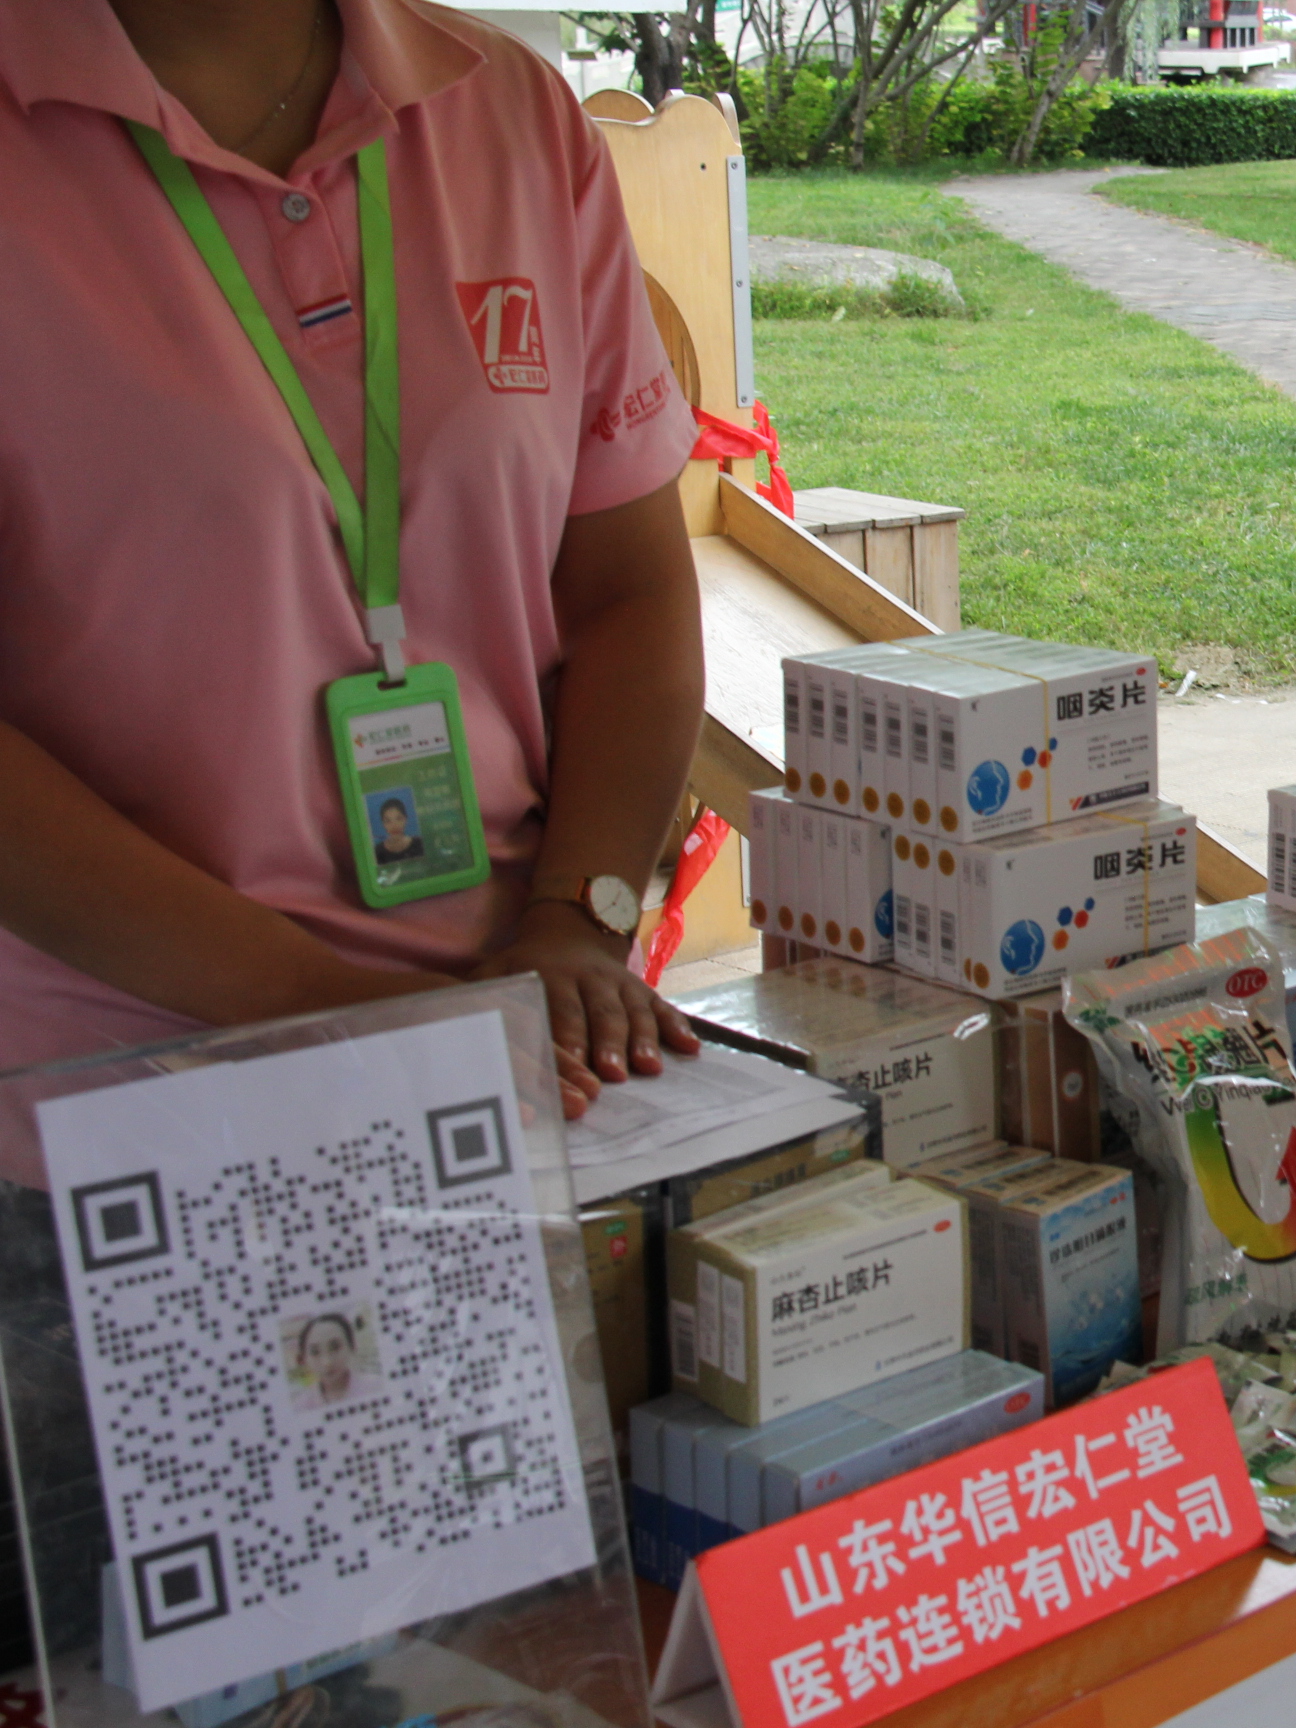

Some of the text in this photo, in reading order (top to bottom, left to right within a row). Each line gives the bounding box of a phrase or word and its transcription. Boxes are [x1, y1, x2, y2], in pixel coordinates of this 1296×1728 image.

[1057, 680, 1146, 721] 咽炎片
[1094, 840, 1185, 880] 咽炎片
[1228, 972, 1265, 995] OTC
[771, 1258, 893, 1323] 麻杏止咳片
[780, 1404, 1184, 1618] 山东华信宏仁堂
[770, 1474, 1233, 1727] 医药连锁有限公司
